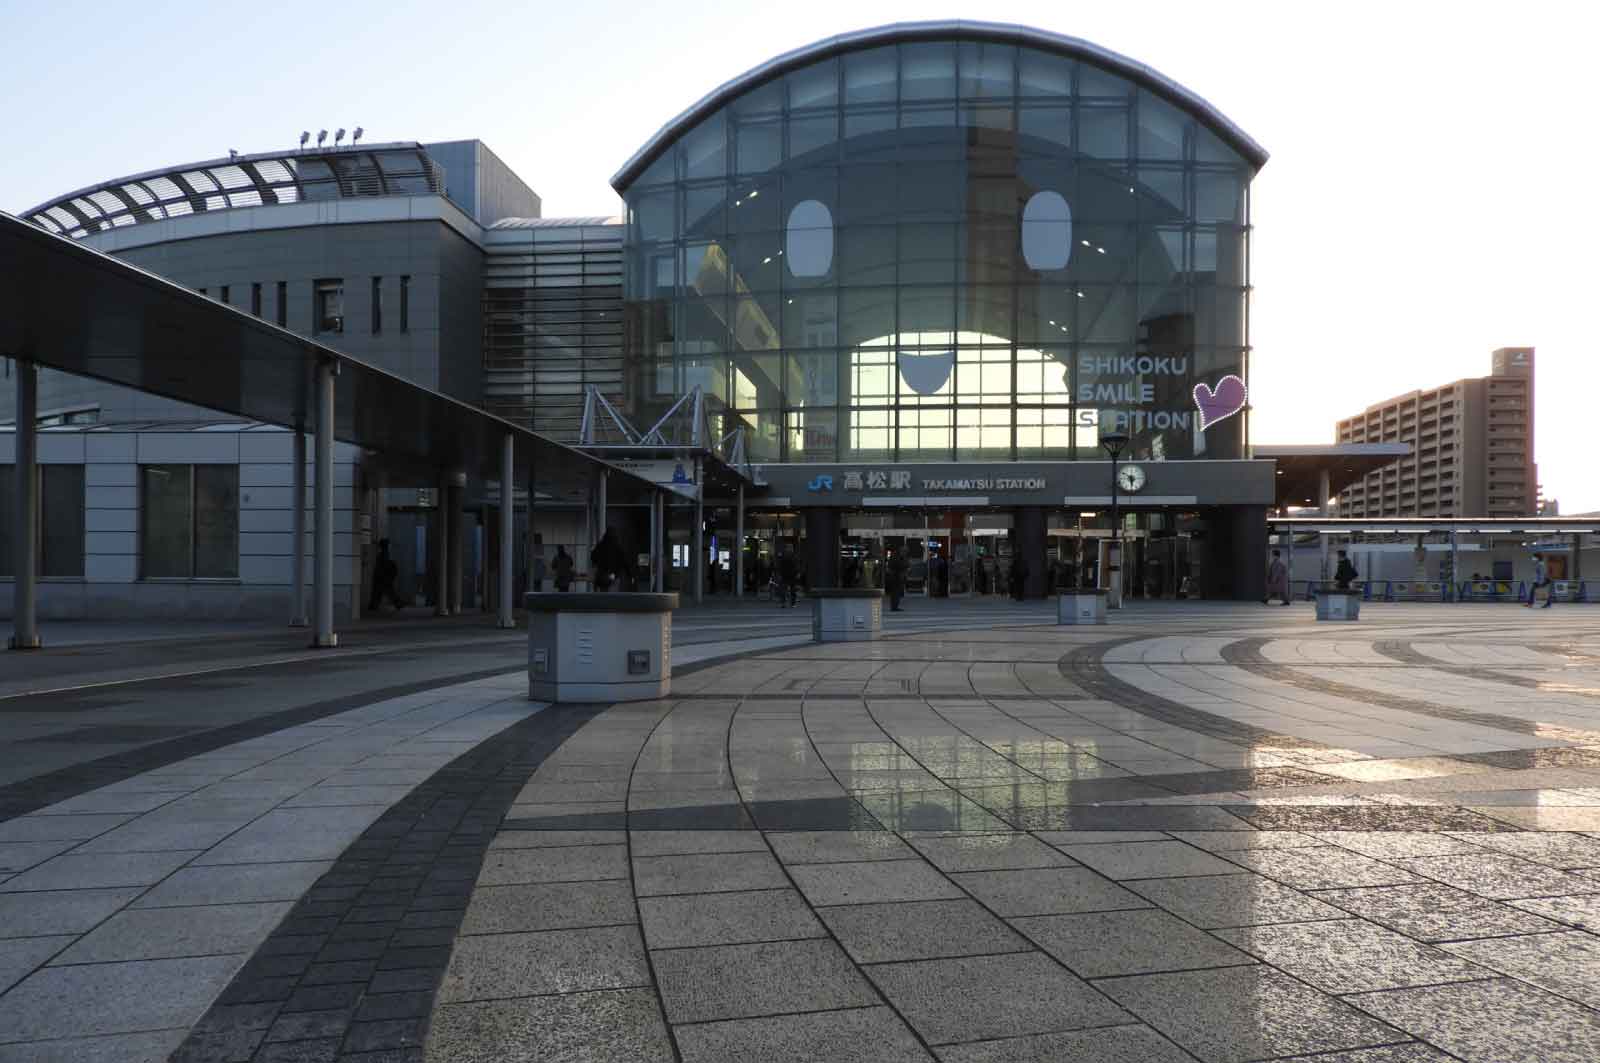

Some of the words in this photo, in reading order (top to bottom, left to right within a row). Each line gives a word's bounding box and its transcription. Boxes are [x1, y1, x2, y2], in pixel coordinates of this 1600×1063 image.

[1079, 356, 1187, 375] SHIKOKU
[1079, 383, 1155, 402] SMILE
[1079, 409, 1187, 429] STATION
[808, 473, 833, 489] JR
[843, 471, 911, 489] 高松駅
[922, 479, 993, 489] TAKAMATSU
[995, 479, 1047, 489] STATION
